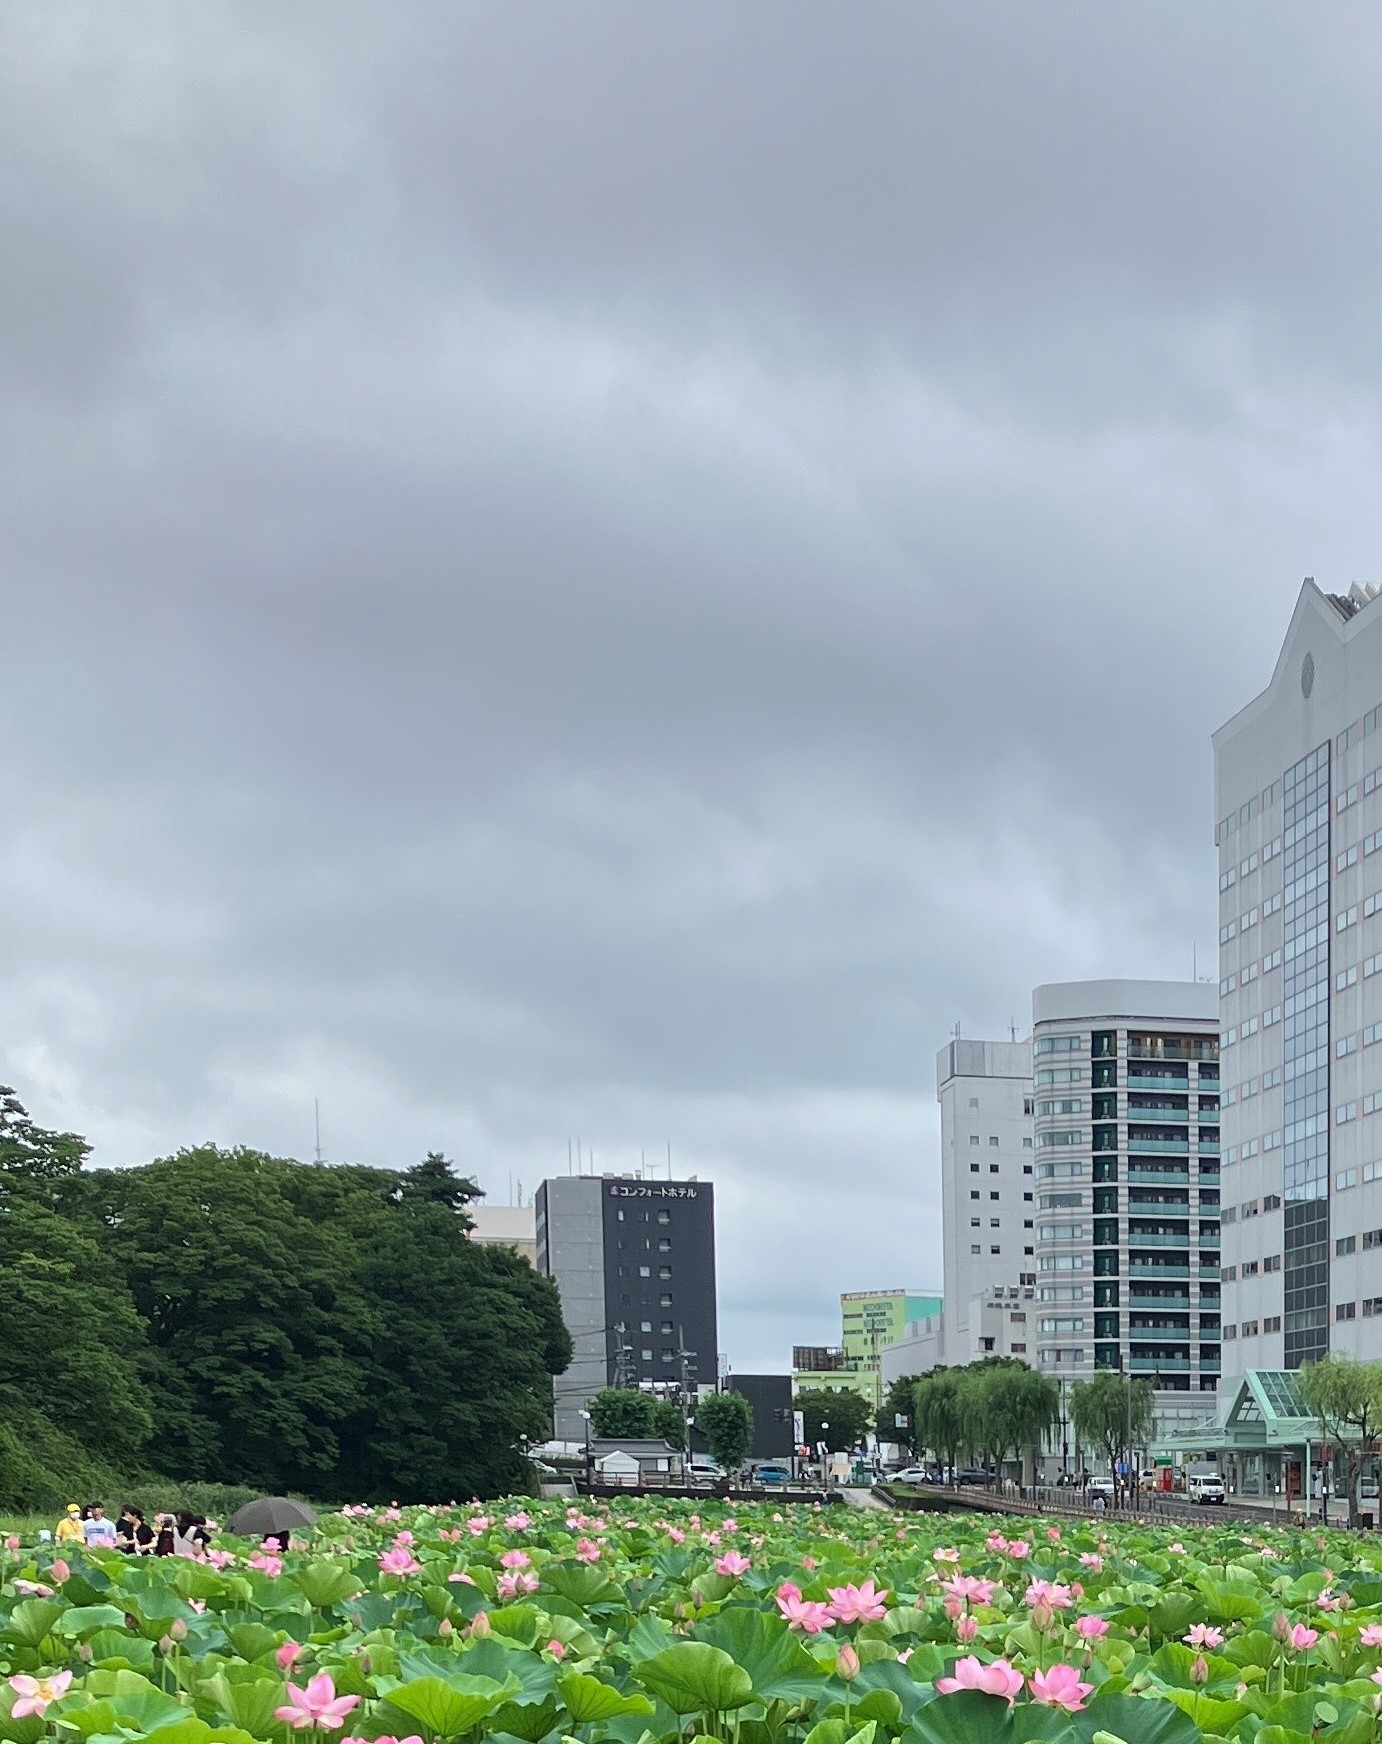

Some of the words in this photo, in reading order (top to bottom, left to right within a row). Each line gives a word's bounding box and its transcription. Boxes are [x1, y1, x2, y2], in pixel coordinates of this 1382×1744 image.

[619, 1186, 698, 1198] コンフォートホテル
